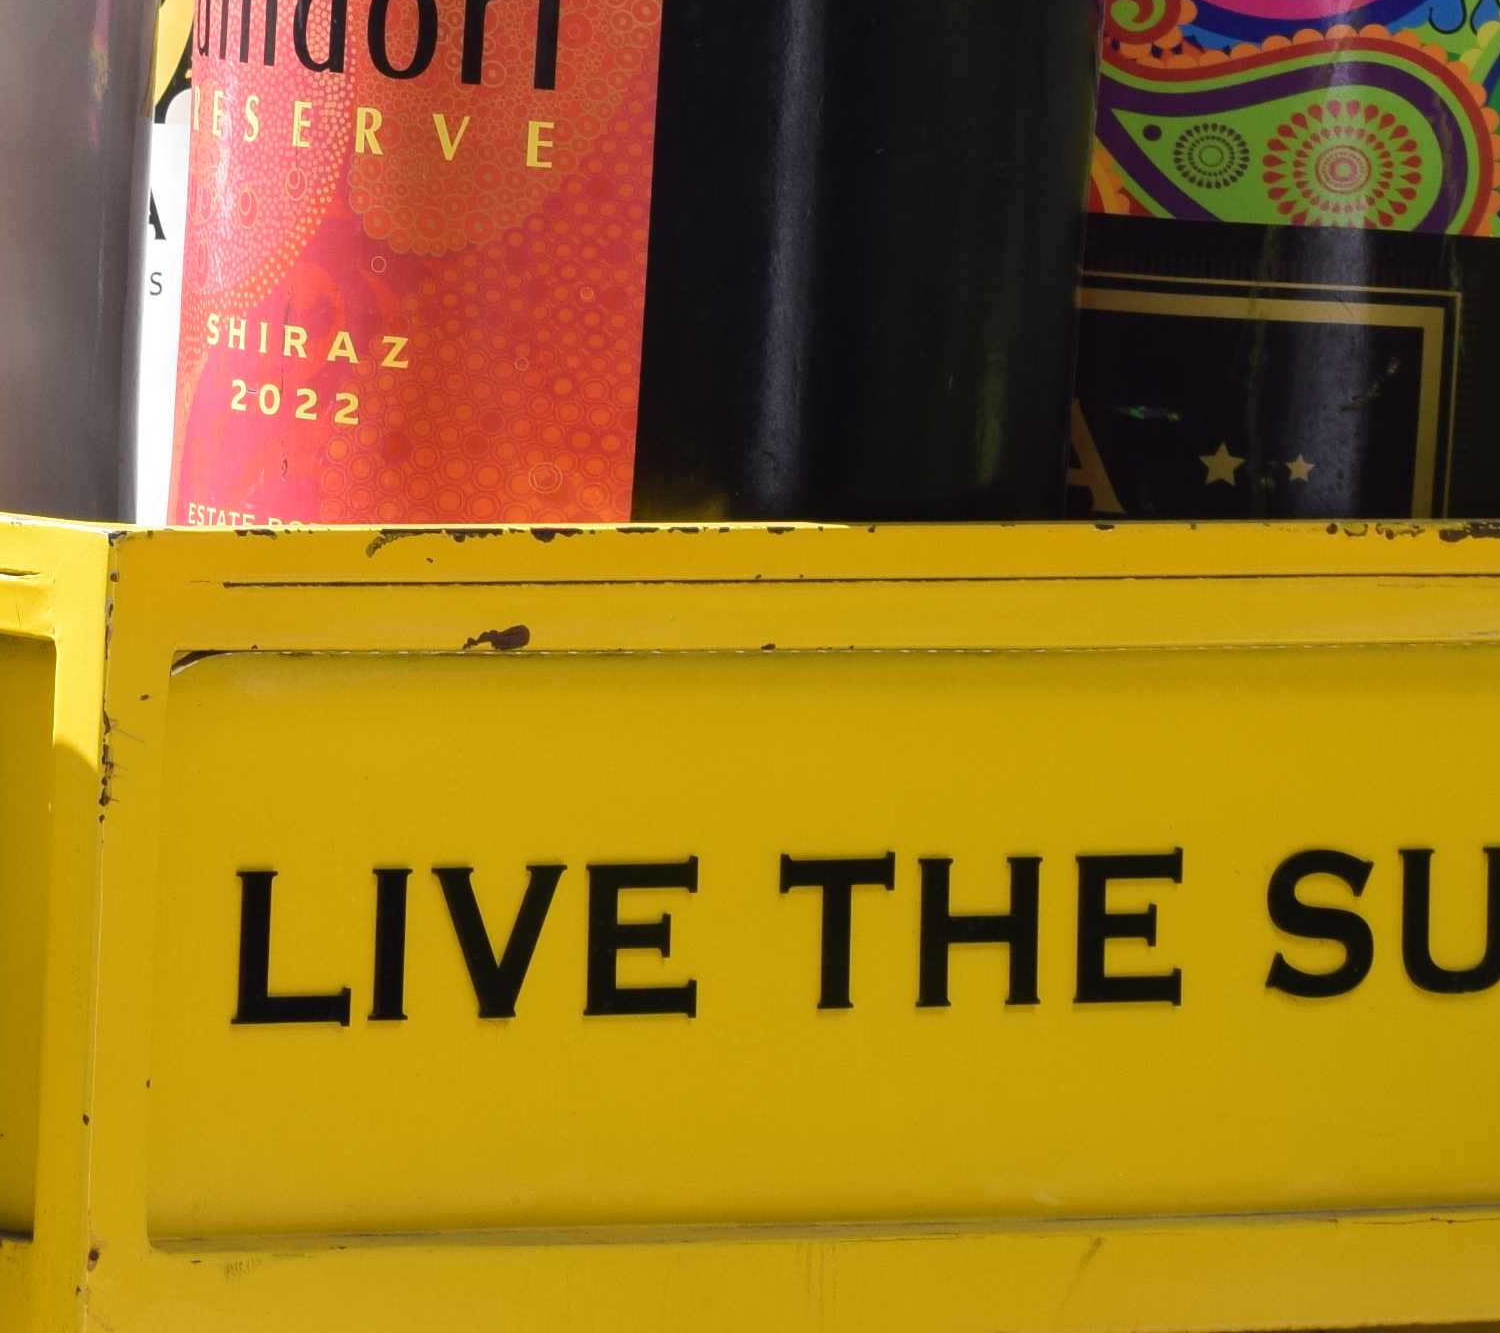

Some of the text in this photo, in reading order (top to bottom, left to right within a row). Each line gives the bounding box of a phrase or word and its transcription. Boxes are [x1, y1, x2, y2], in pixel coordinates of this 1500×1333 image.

[206, 312, 410, 370] SHIRAZ
[230, 378, 361, 426] 2022
[187, 501, 256, 529] ESTATE
[230, 854, 700, 1028] LIVE
[778, 846, 1184, 1011] THE
